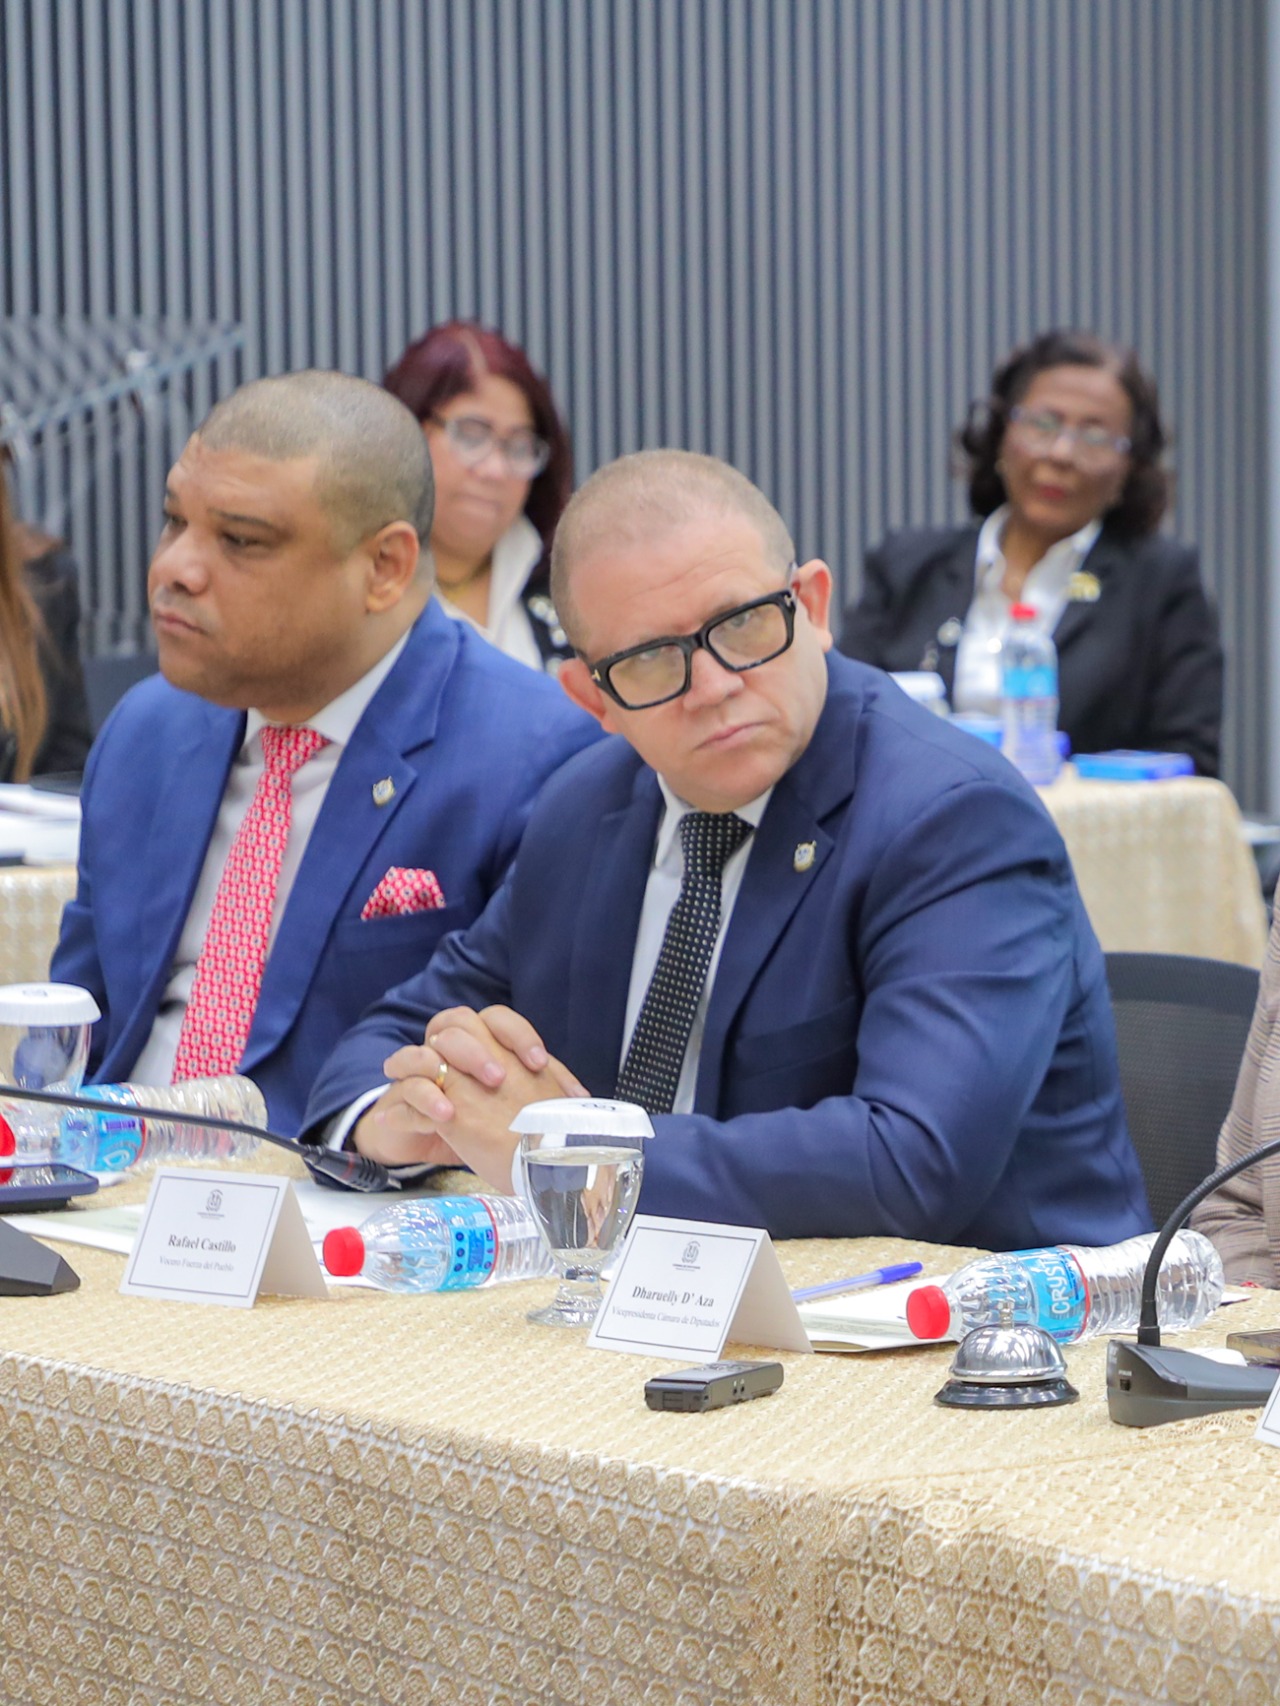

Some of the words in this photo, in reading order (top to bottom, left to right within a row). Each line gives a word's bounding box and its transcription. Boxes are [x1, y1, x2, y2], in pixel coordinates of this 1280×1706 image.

[168, 1234, 200, 1250] Rafael
[201, 1238, 237, 1252] Castillo
[203, 1261, 213, 1270] del
[632, 1286, 678, 1305] Dharuelly
[696, 1294, 714, 1307] Aza
[612, 1306, 656, 1319] Vicepresidenta
[680, 1315, 689, 1324] de
[689, 1316, 720, 1328] Diputados
